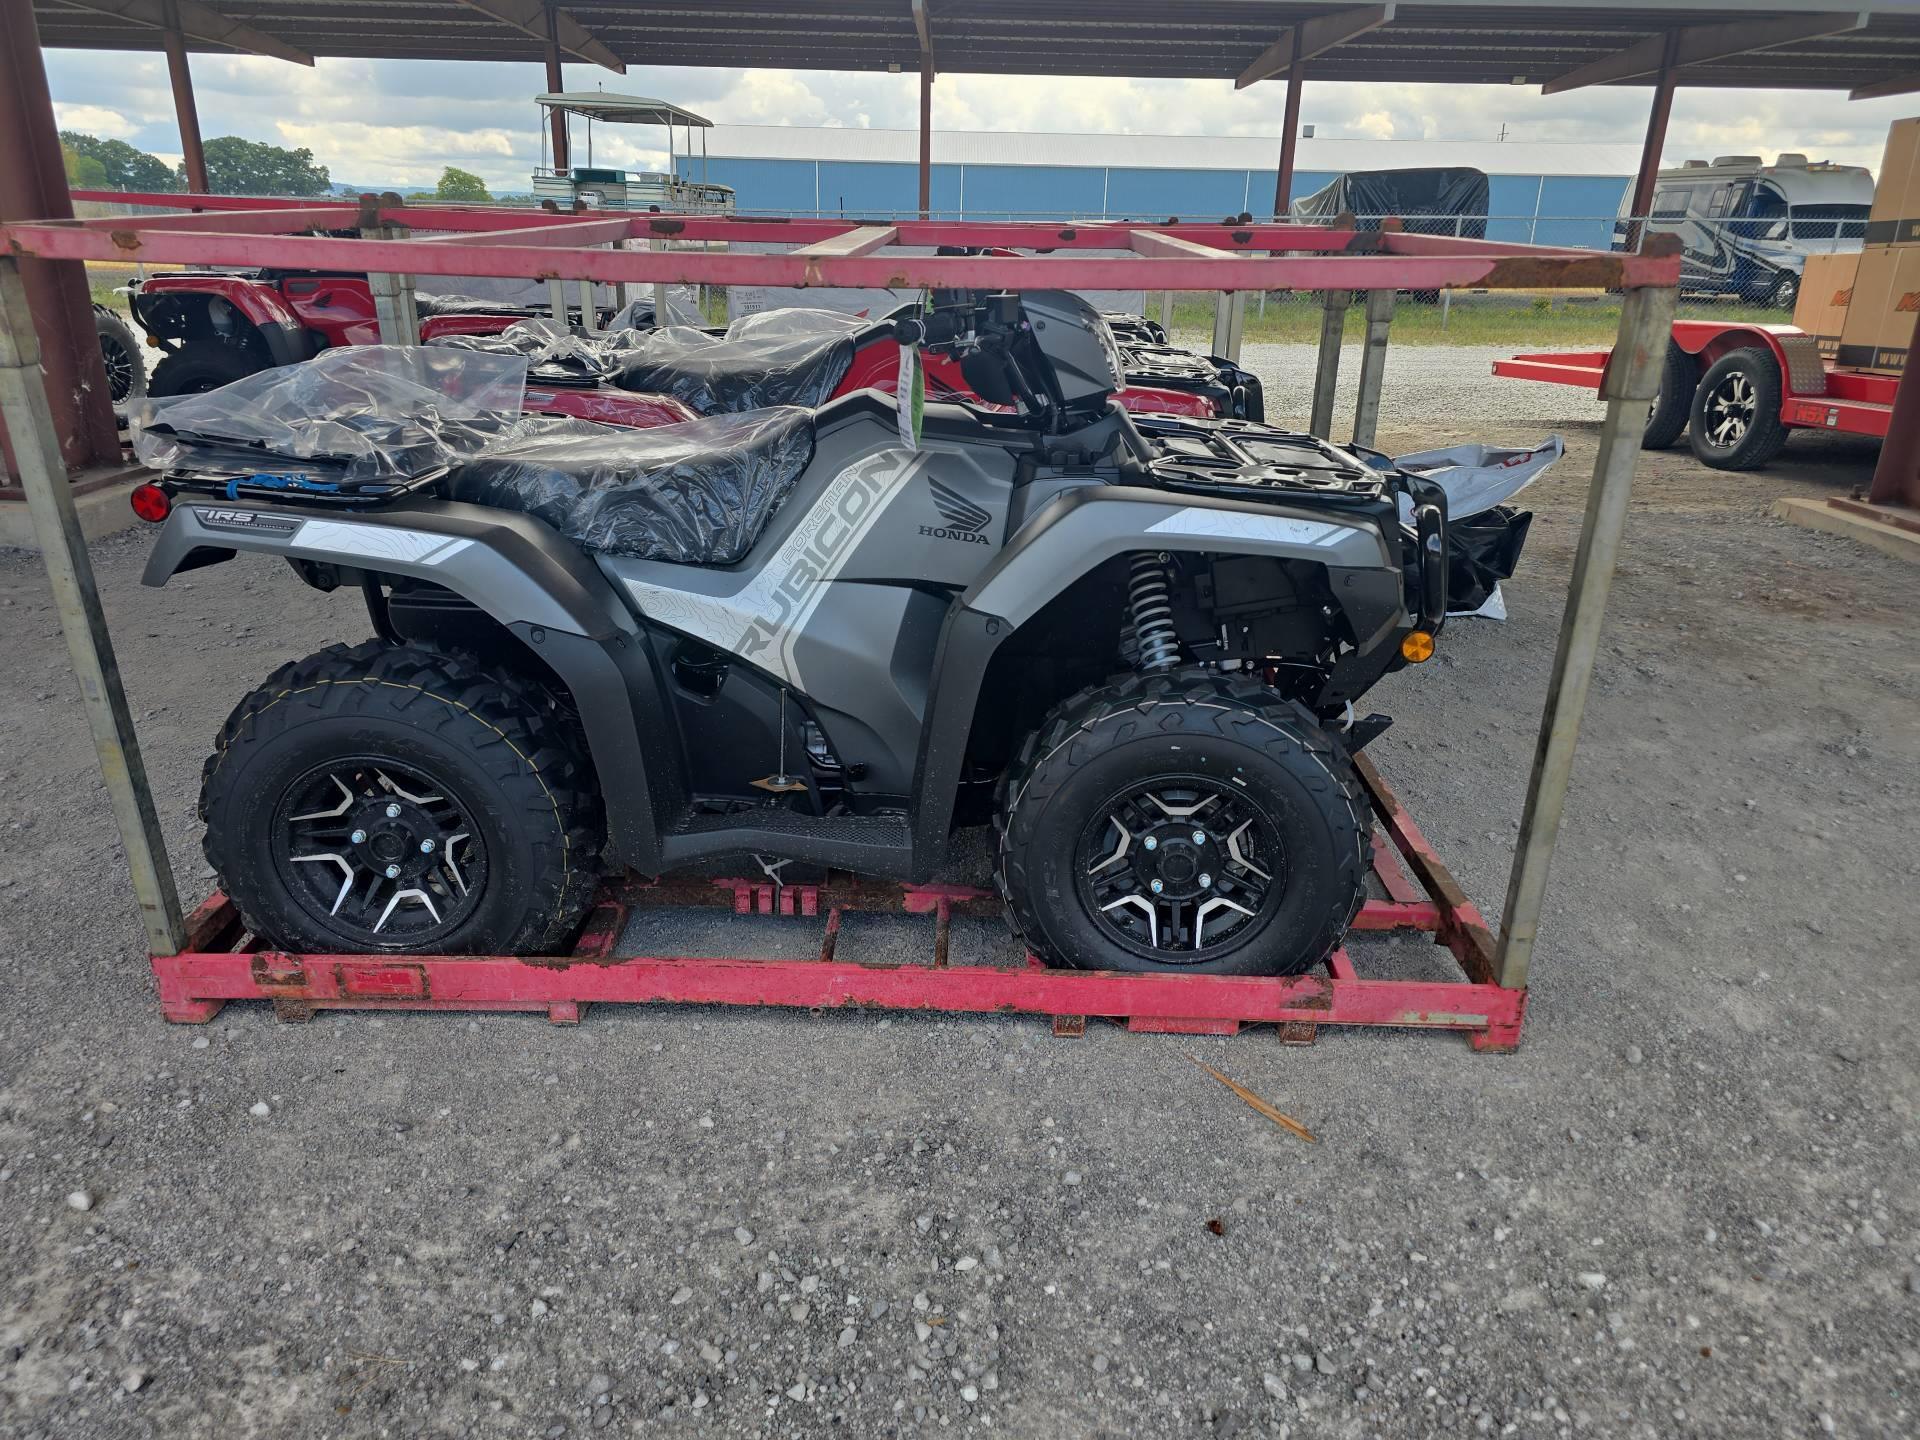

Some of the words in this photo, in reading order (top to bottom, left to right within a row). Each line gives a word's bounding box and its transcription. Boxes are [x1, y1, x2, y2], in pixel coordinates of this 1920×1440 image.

[207, 511, 254, 522] IRS
[782, 466, 860, 565] FOREMAN
[918, 525, 991, 546] HONDA
[733, 451, 901, 656] RUBICON
